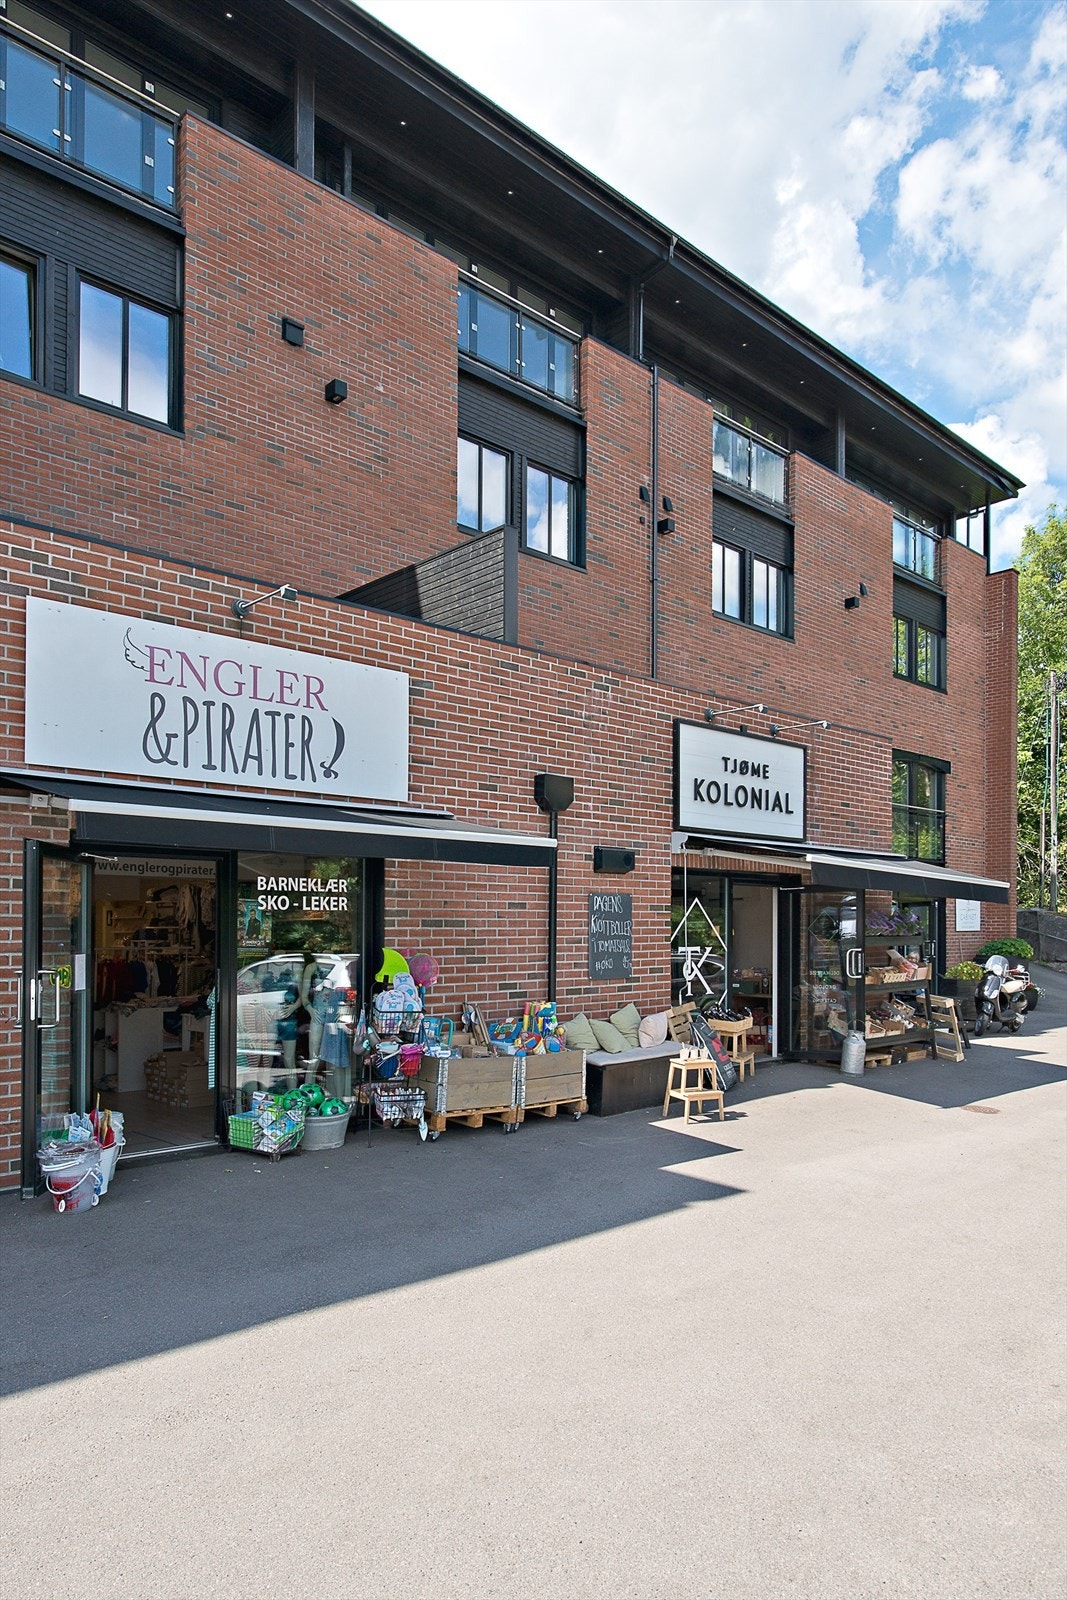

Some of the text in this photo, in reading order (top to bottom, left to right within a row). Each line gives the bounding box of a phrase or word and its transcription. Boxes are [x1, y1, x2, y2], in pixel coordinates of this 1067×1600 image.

[144, 644, 329, 712] ENGLER
[722, 756, 770, 779] TJØME
[693, 777, 794, 814] KOLONIAL
[257, 876, 348, 893] BARNEKLÆR
[257, 895, 290, 911] SKO
[302, 896, 348, 911] LEKER
[593, 895, 623, 913] DAGENS
